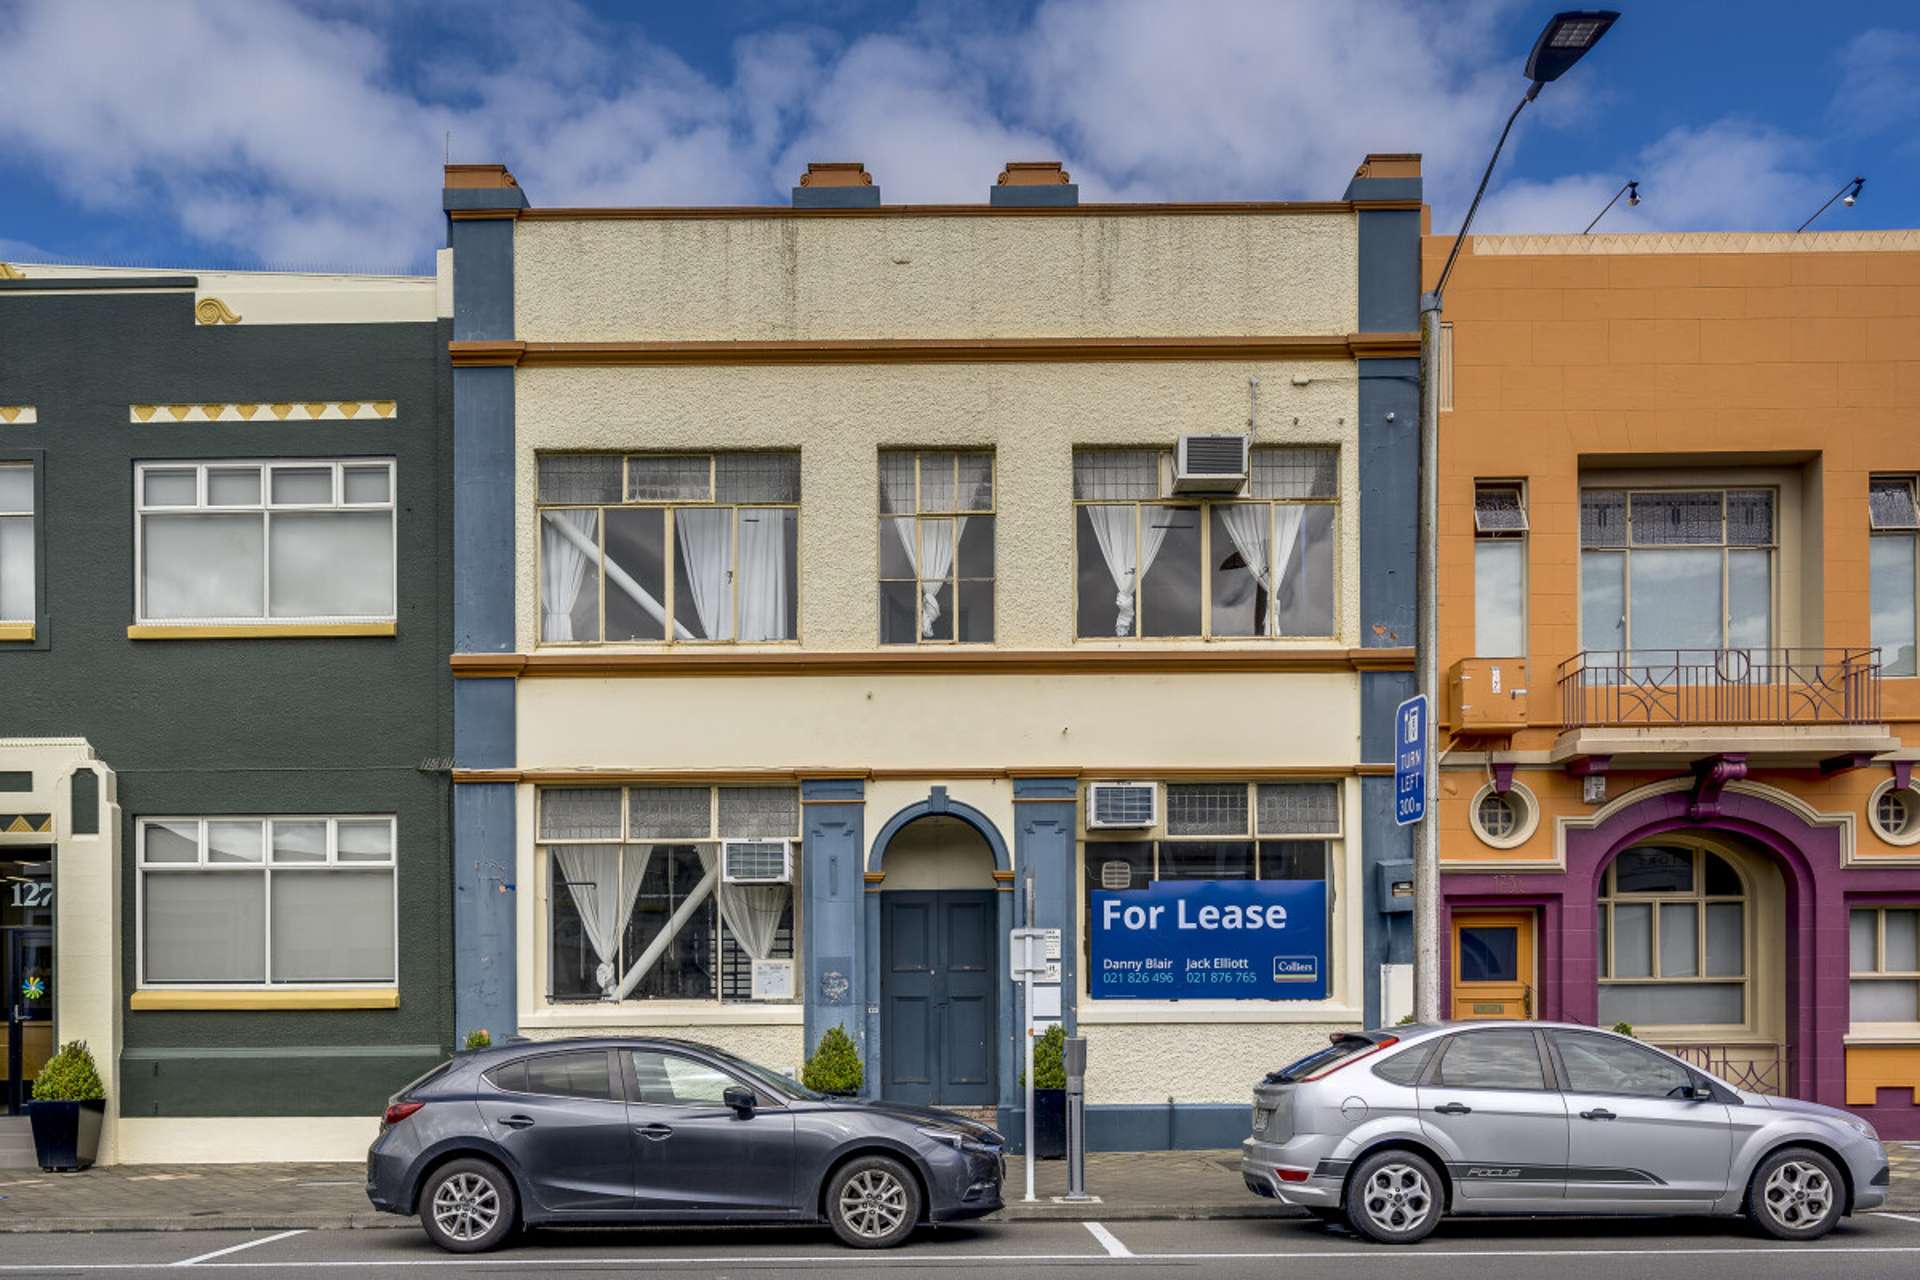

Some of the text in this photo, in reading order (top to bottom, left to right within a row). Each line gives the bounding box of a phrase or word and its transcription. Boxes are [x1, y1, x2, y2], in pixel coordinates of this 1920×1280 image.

[1401, 748, 1421, 770] TURN
[1401, 772, 1420, 793] LEFT
[11, 882, 53, 907] 127
[1103, 899, 1287, 930] For Lease
[1103, 957, 1173, 971] Danny Blair
[1185, 957, 1249, 971] Jack Elliott
[1278, 960, 1313, 972] Colliers
[1103, 972, 1174, 983] 021 826 496
[1186, 972, 1257, 983] 021 876 765
[1466, 1167, 1521, 1178] FOCUS
